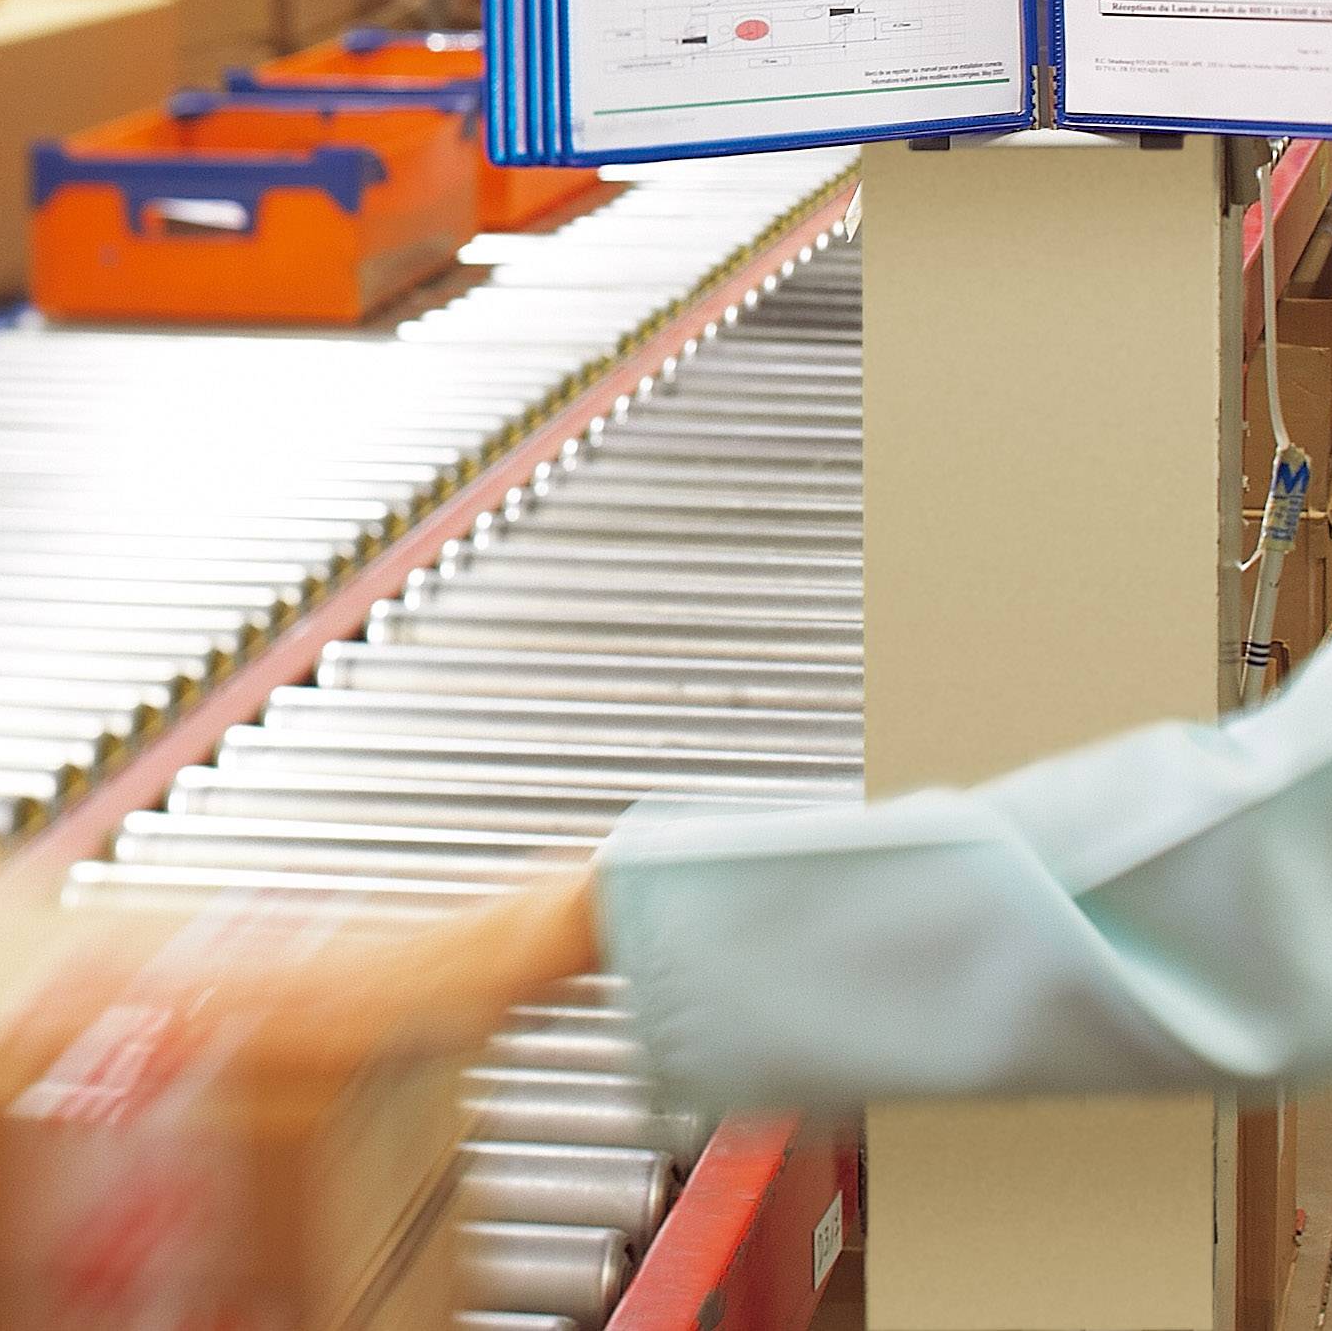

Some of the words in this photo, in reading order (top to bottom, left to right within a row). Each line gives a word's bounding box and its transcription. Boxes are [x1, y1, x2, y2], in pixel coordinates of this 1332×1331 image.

[1111, 2, 1157, 13] Réceptions
[1157, 3, 1169, 12] du
[1172, 3, 1197, 13] Lundi
[1211, 5, 1234, 14] Jeudi
